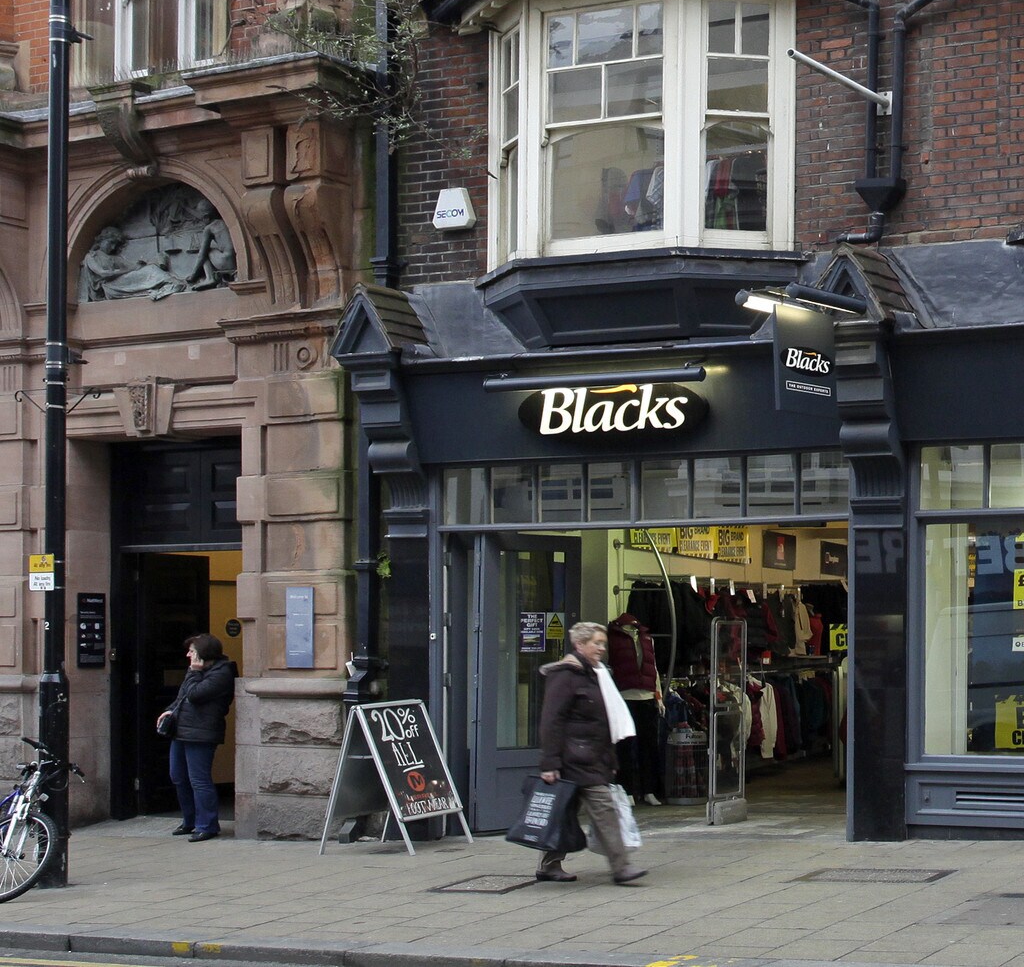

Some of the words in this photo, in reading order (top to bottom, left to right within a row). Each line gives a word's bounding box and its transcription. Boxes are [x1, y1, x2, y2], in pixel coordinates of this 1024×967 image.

[436, 209, 464, 218] SECOM
[785, 348, 830, 373] Blacks
[540, 384, 688, 435] Blacks
[680, 527, 693, 539] BIG
[718, 529, 730, 545] BIG
[731, 532, 744, 541] BRAND
[371, 708, 416, 742] 20%
[405, 725, 420, 739] off
[392, 742, 424, 767] ALL
[406, 797, 449, 815] FOOTWEAR
